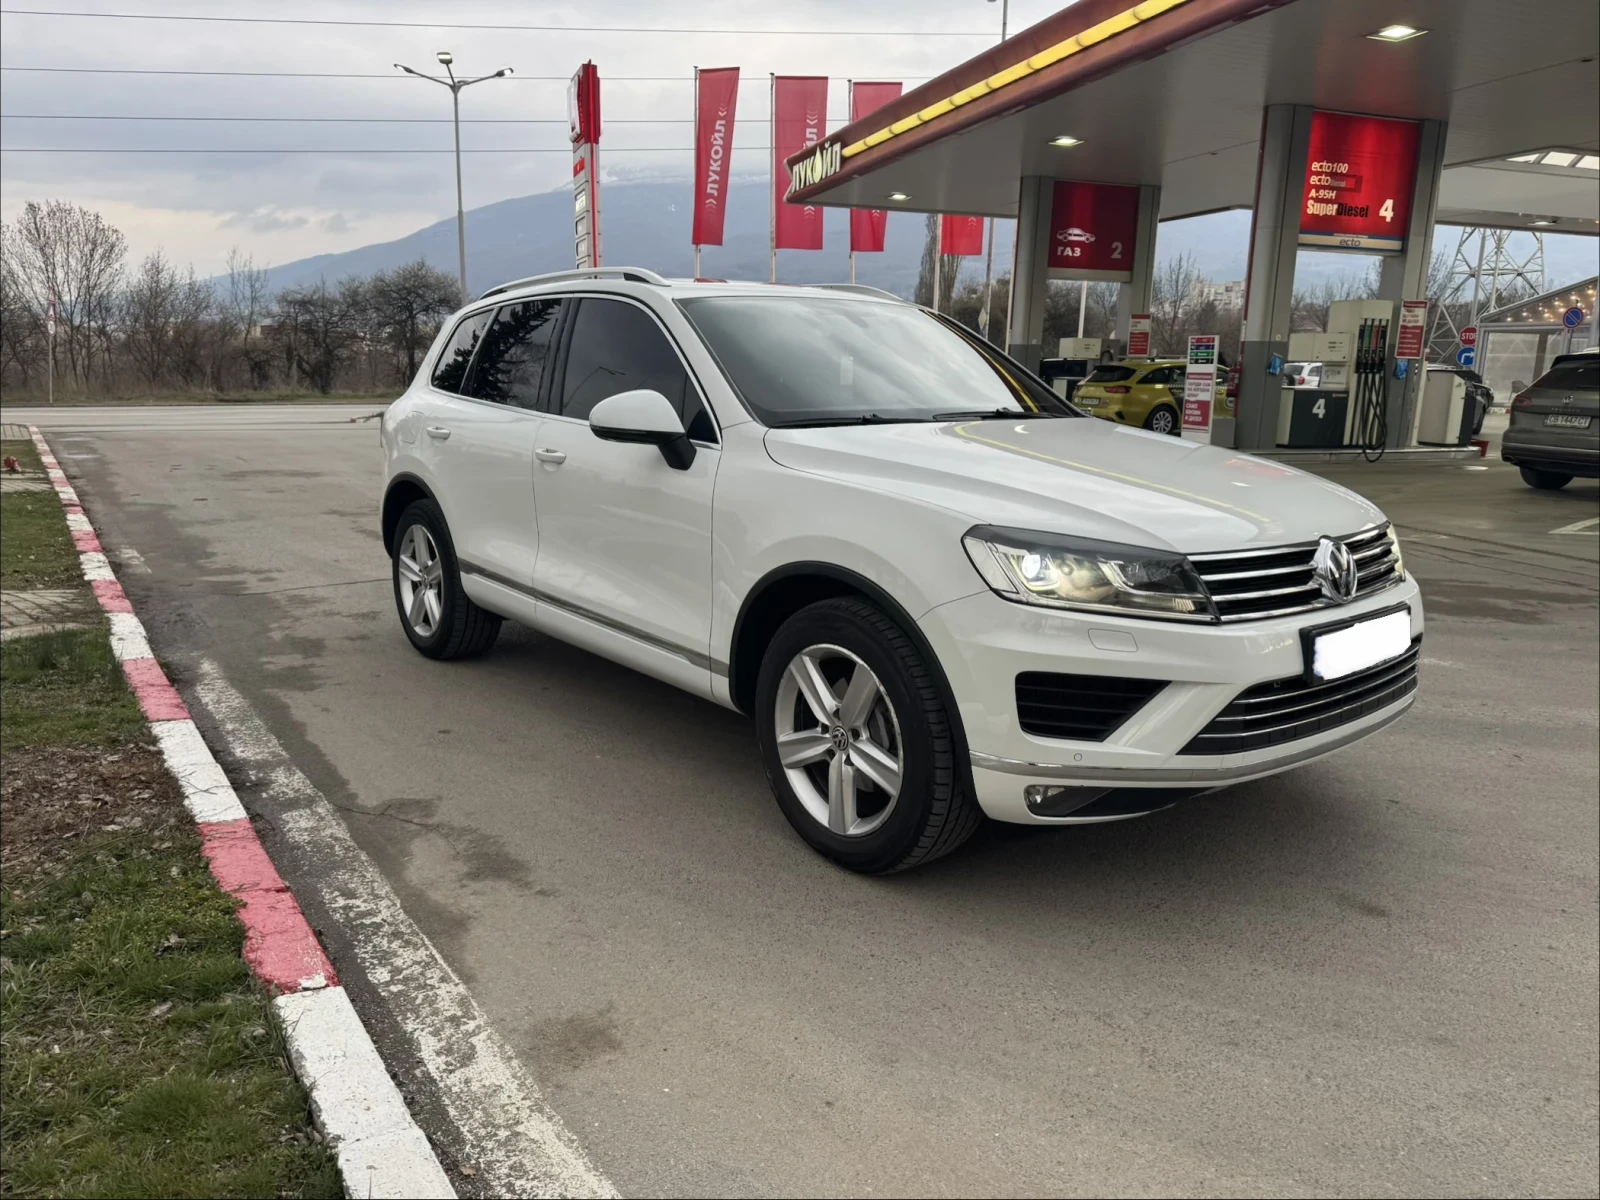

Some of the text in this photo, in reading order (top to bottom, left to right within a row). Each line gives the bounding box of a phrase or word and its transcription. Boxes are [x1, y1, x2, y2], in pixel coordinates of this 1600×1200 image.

[706, 119, 726, 197] ЛУКОЙЛ
[791, 140, 841, 193] ЛУКОЙЛ
[1311, 160, 1348, 174] ecto100
[1308, 188, 1337, 200] A-95H
[1306, 199, 1369, 218] SuperDiesel
[1378, 198, 1394, 223] 4
[1057, 246, 1082, 257] ГАЗ
[1110, 241, 1123, 259] 2
[1339, 238, 1361, 247] ecto
[1312, 398, 1326, 419] 4
